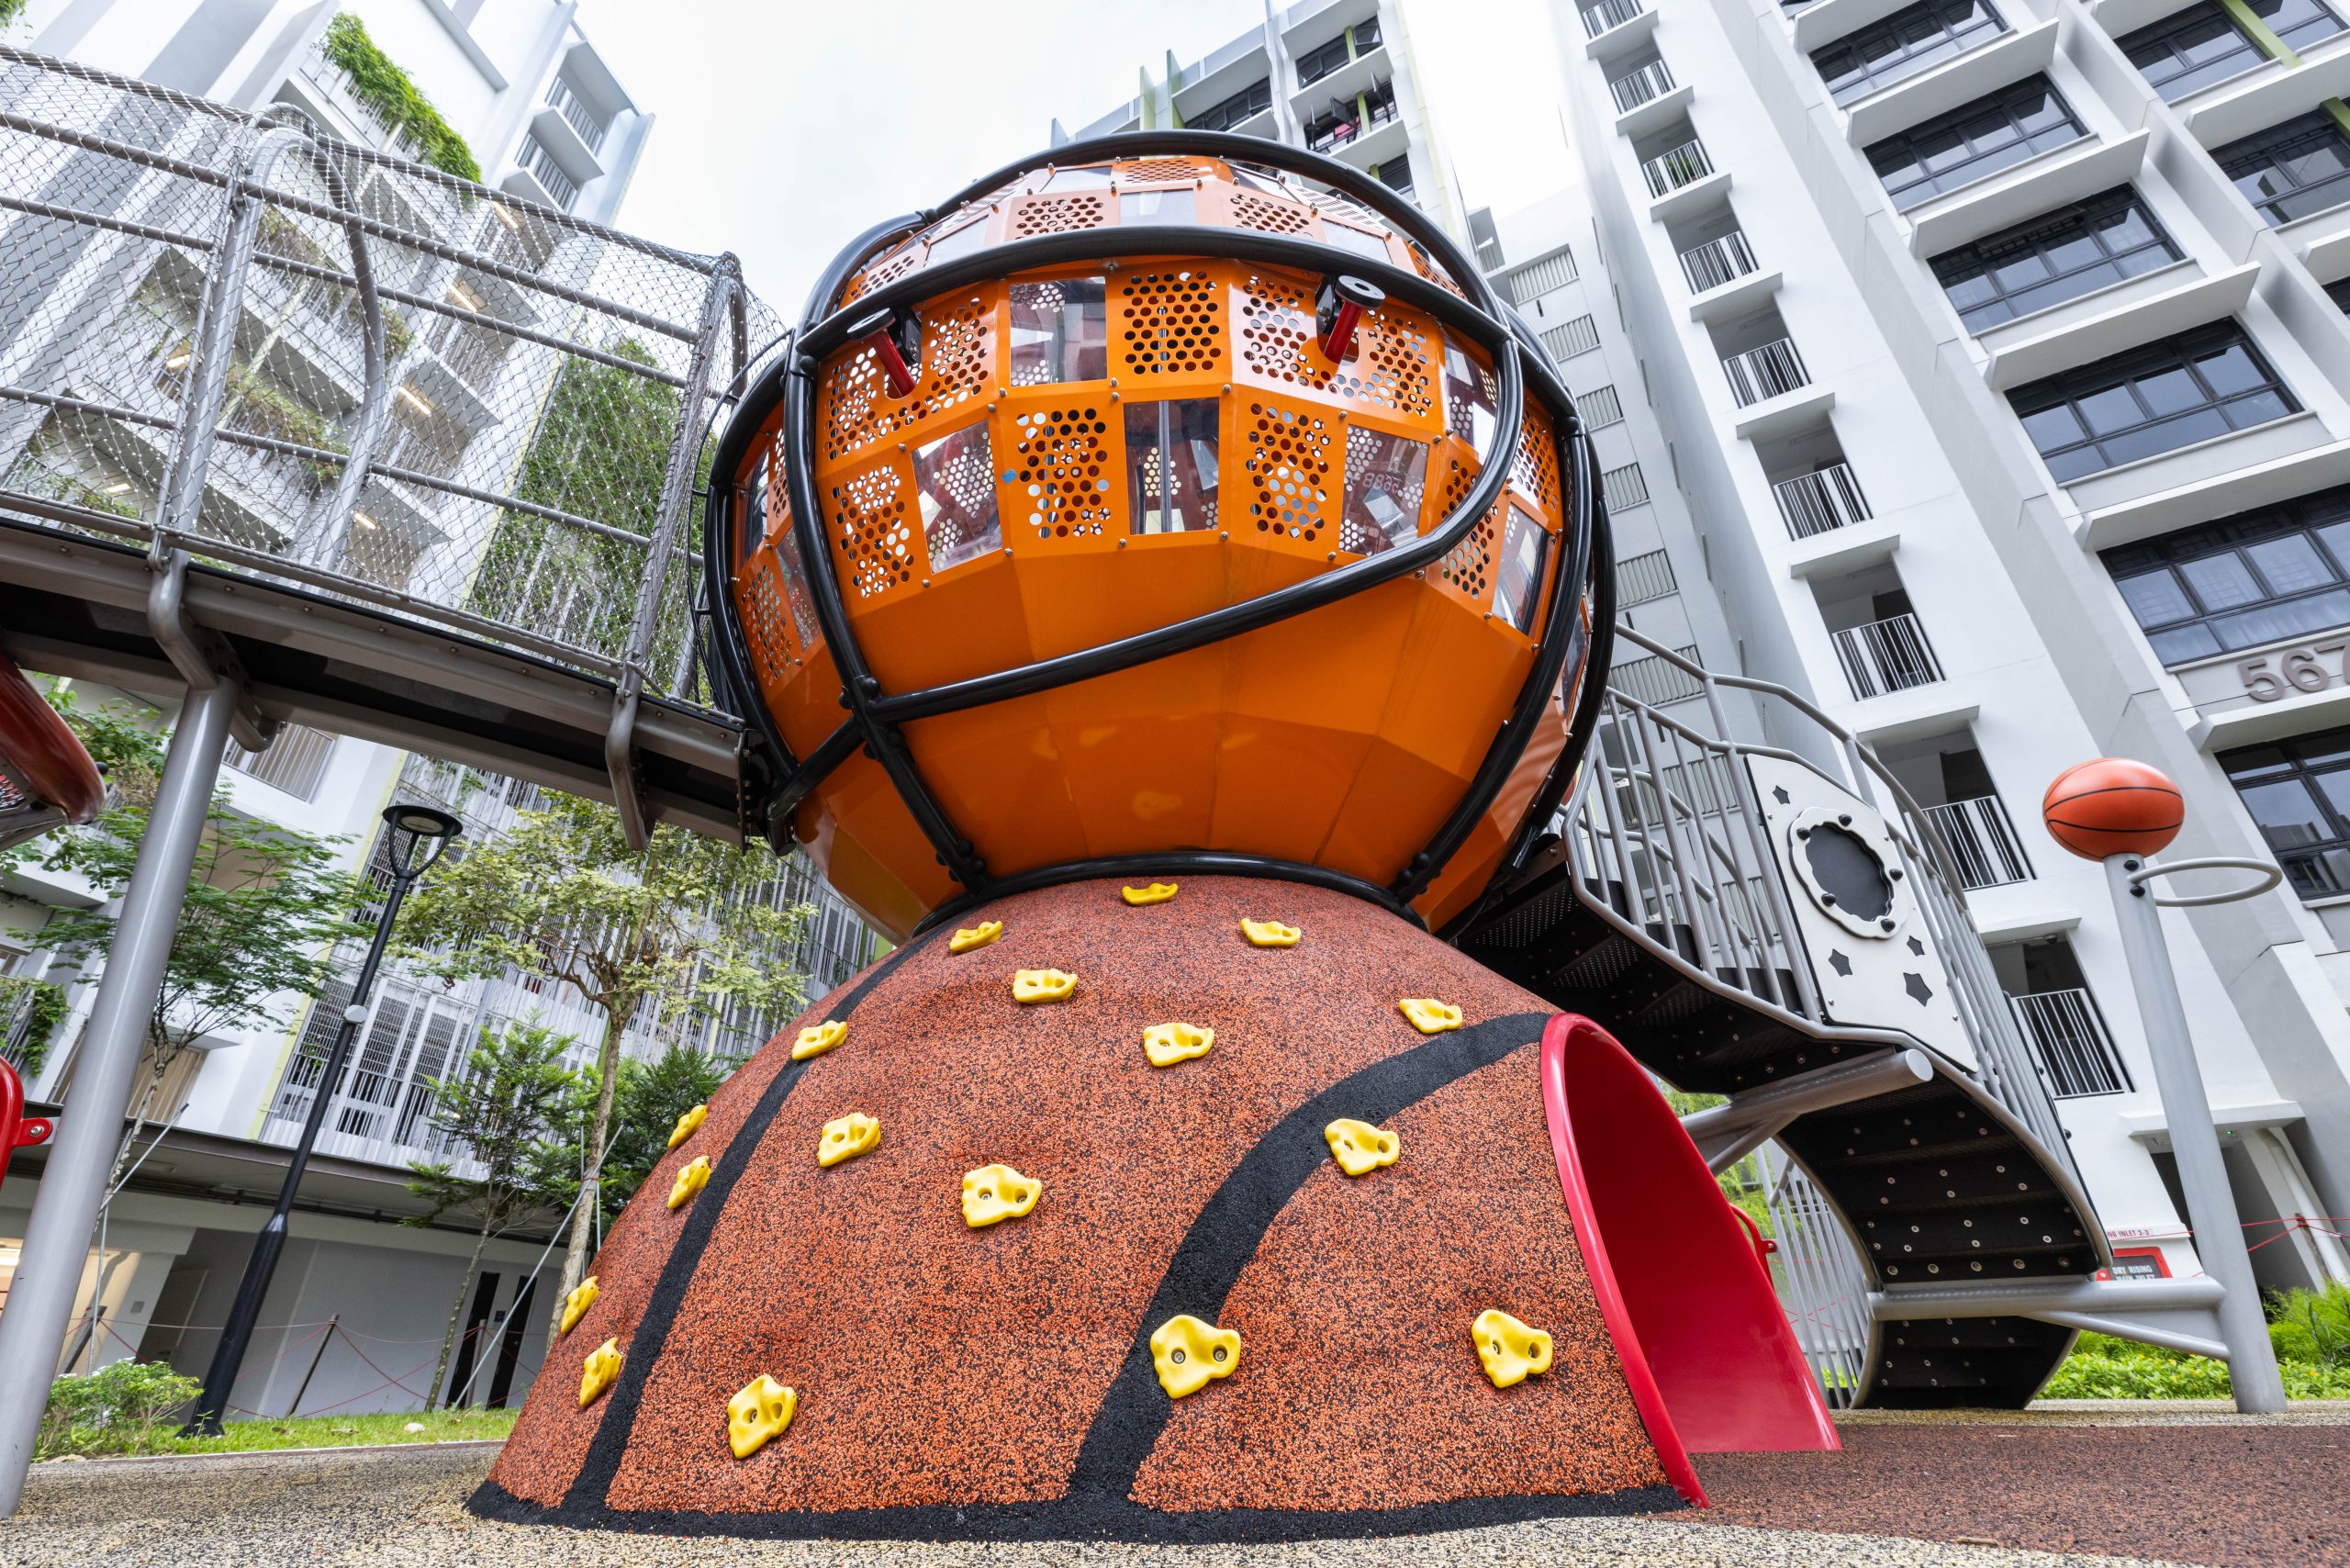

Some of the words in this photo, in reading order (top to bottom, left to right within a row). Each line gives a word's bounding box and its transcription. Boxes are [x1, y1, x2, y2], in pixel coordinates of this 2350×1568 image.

[2237, 638, 2350, 702] 567
[2112, 1266, 2126, 1274] DRY
[2128, 1265, 2153, 1274] RISING
